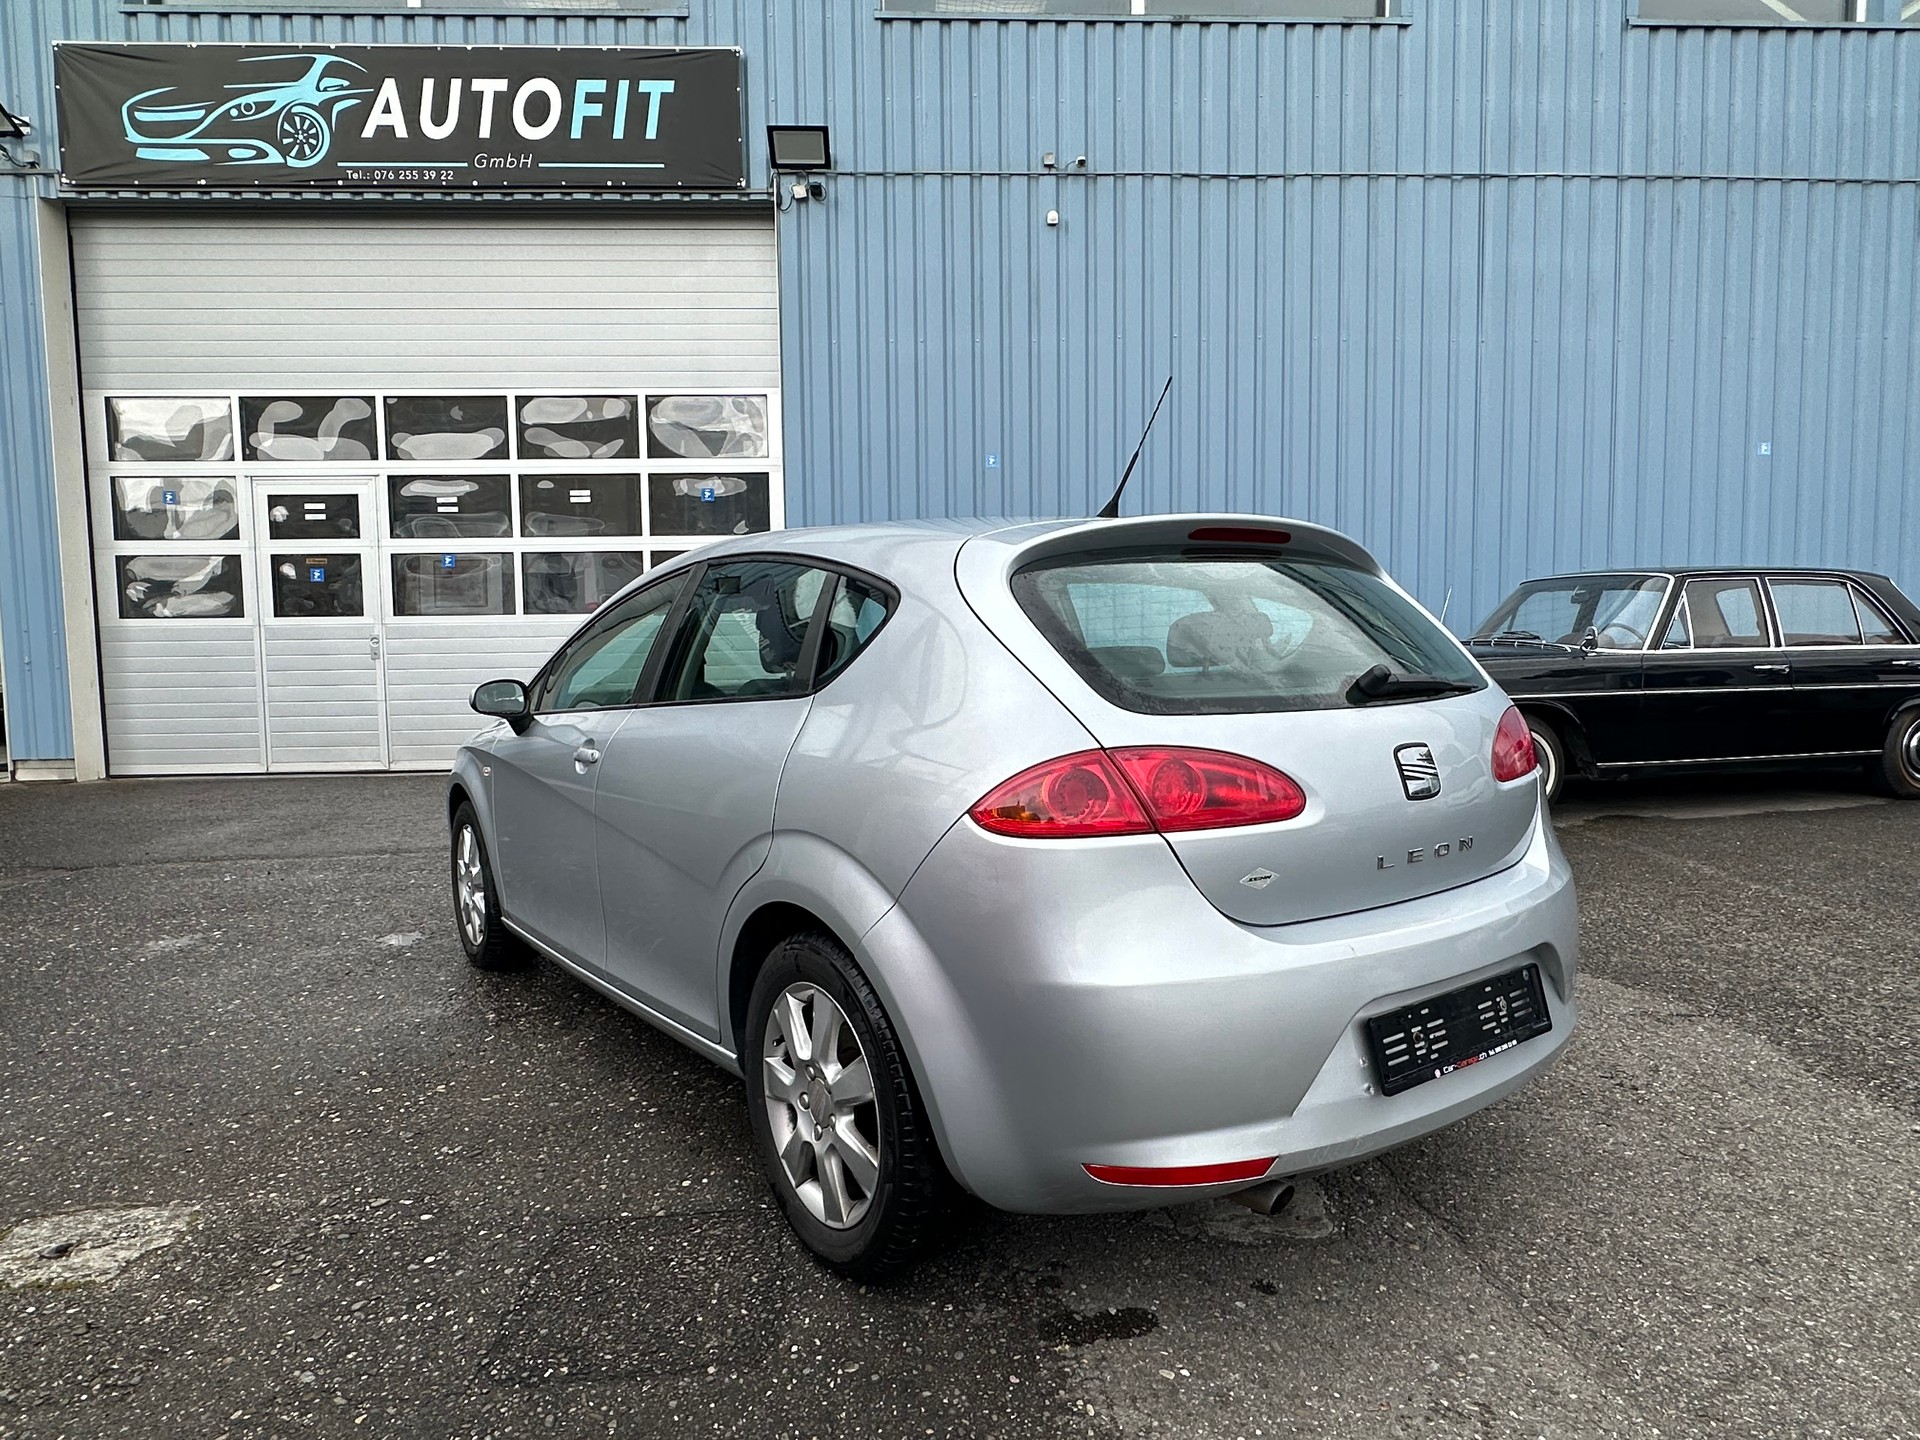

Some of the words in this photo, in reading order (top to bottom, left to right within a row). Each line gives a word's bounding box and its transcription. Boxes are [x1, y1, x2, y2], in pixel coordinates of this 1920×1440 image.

[360, 77, 676, 141] AUTOFIT
[474, 152, 533, 169] GmbH
[346, 170, 371, 180] Tel.:
[374, 170, 395, 180] 076
[398, 170, 419, 180] 255
[423, 170, 436, 180] 39
[440, 170, 454, 180] 22
[1377, 835, 1474, 871] LEON
